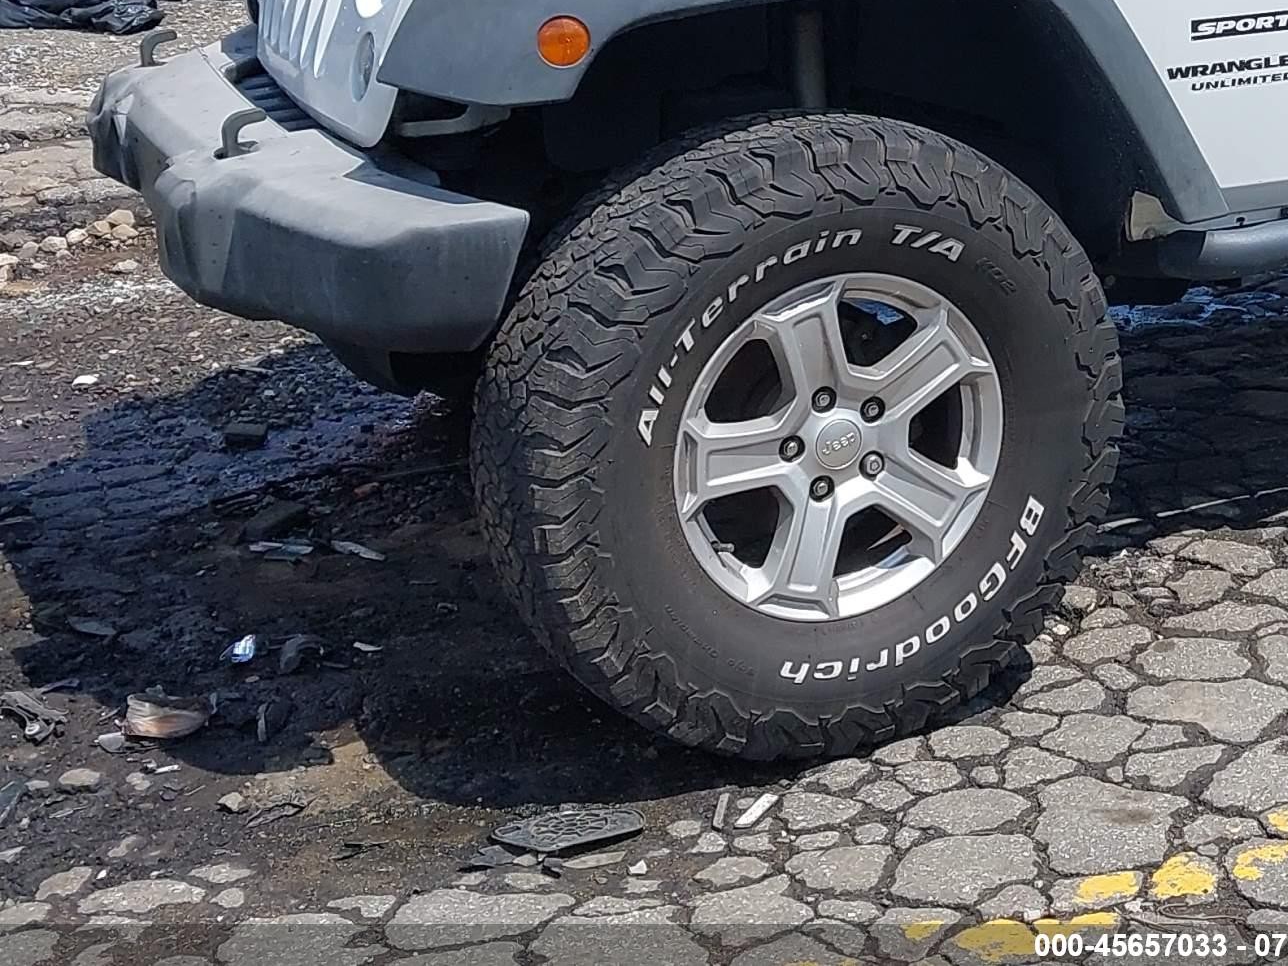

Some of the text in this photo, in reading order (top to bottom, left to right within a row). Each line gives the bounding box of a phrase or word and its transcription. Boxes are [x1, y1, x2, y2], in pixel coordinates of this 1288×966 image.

[635, 226, 863, 448] All-Terrain
[889, 223, 969, 263] T/A
[822, 432, 856, 456] Jeep
[778, 494, 1047, 687] BFGoodrich
